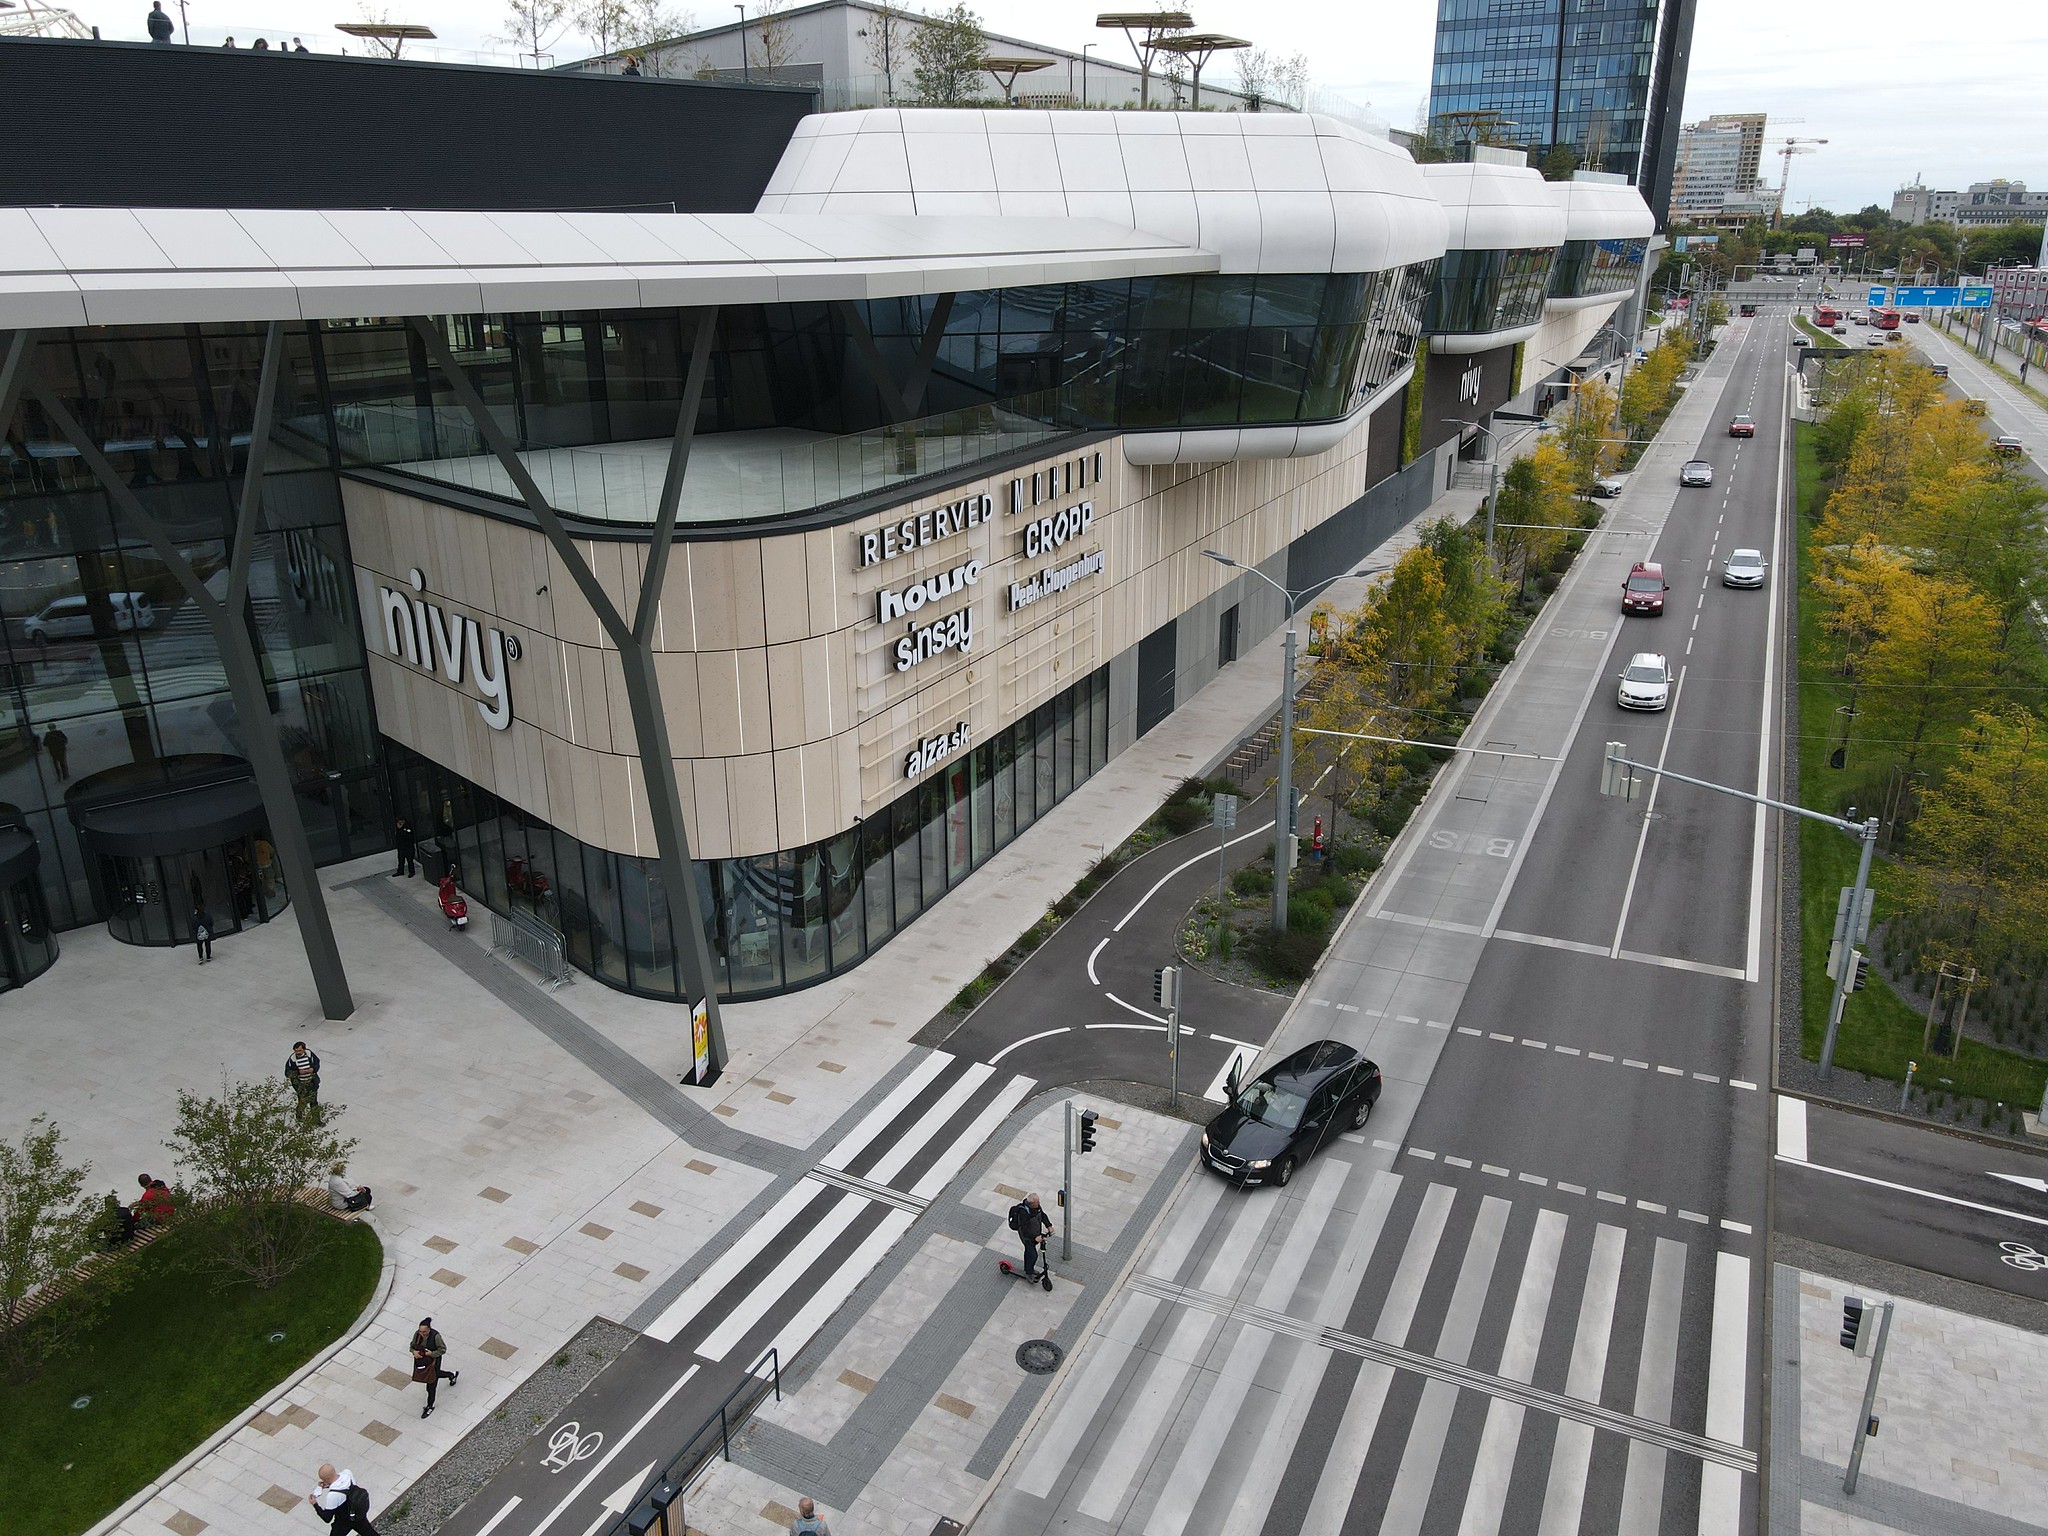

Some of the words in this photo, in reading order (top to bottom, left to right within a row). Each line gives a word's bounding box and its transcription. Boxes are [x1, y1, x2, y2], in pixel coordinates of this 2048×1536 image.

[1459, 358, 1482, 406] nivy
[1011, 452, 1102, 514] MOHITO
[860, 493, 993, 567] RESERVED
[1023, 501, 1093, 559] CROPP
[893, 606, 974, 673] sinsay
[1550, 627, 1609, 640] BUS
[904, 721, 971, 779] alza.sk
